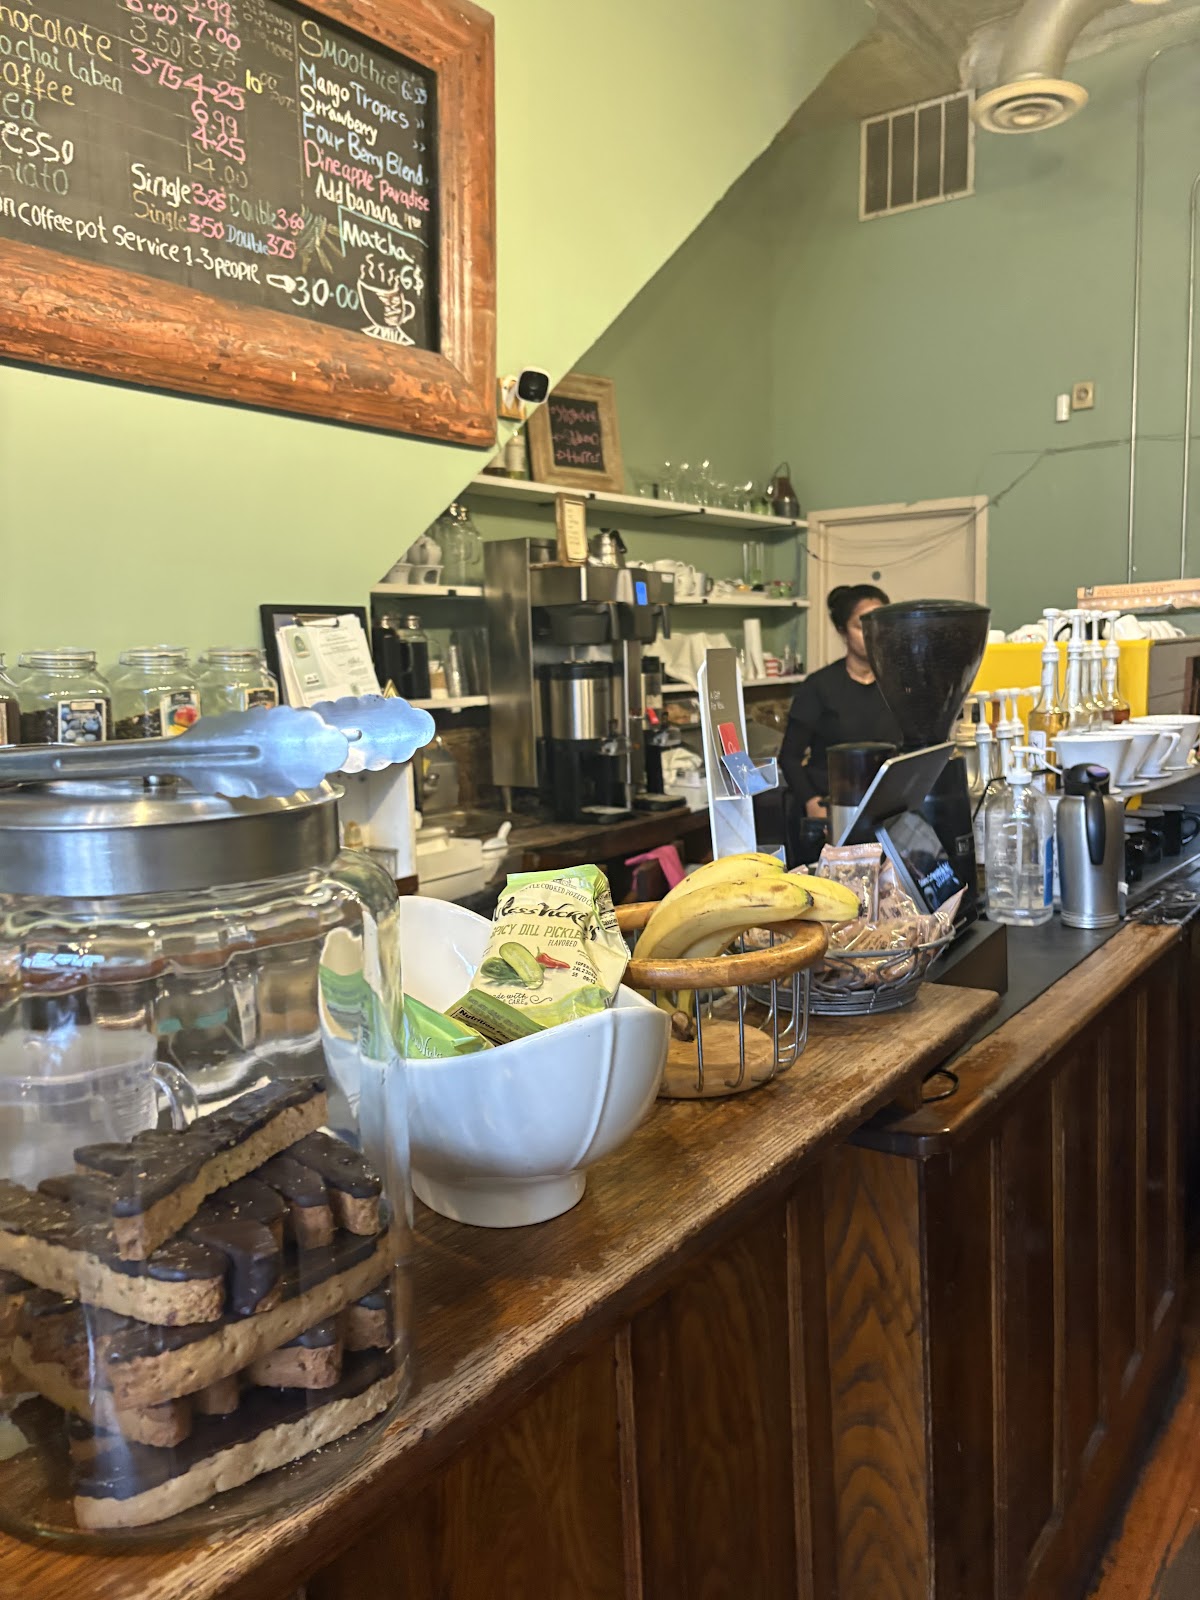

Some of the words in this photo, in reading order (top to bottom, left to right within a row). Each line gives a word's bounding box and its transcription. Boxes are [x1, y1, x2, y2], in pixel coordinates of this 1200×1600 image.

[0, 61, 75, 106] offee
[300, 57, 350, 108] Mango
[349, 81, 409, 129] Tropics
[0, 91, 40, 127] ea
[300, 84, 378, 146] Strawberry
[302, 111, 344, 151] Four
[131, 163, 191, 207] Single
[303, 139, 375, 192] Pineapple
[343, 220, 415, 263] Matcha
[518, 922, 541, 937] DILL
[543, 925, 582, 940] PICKLE
